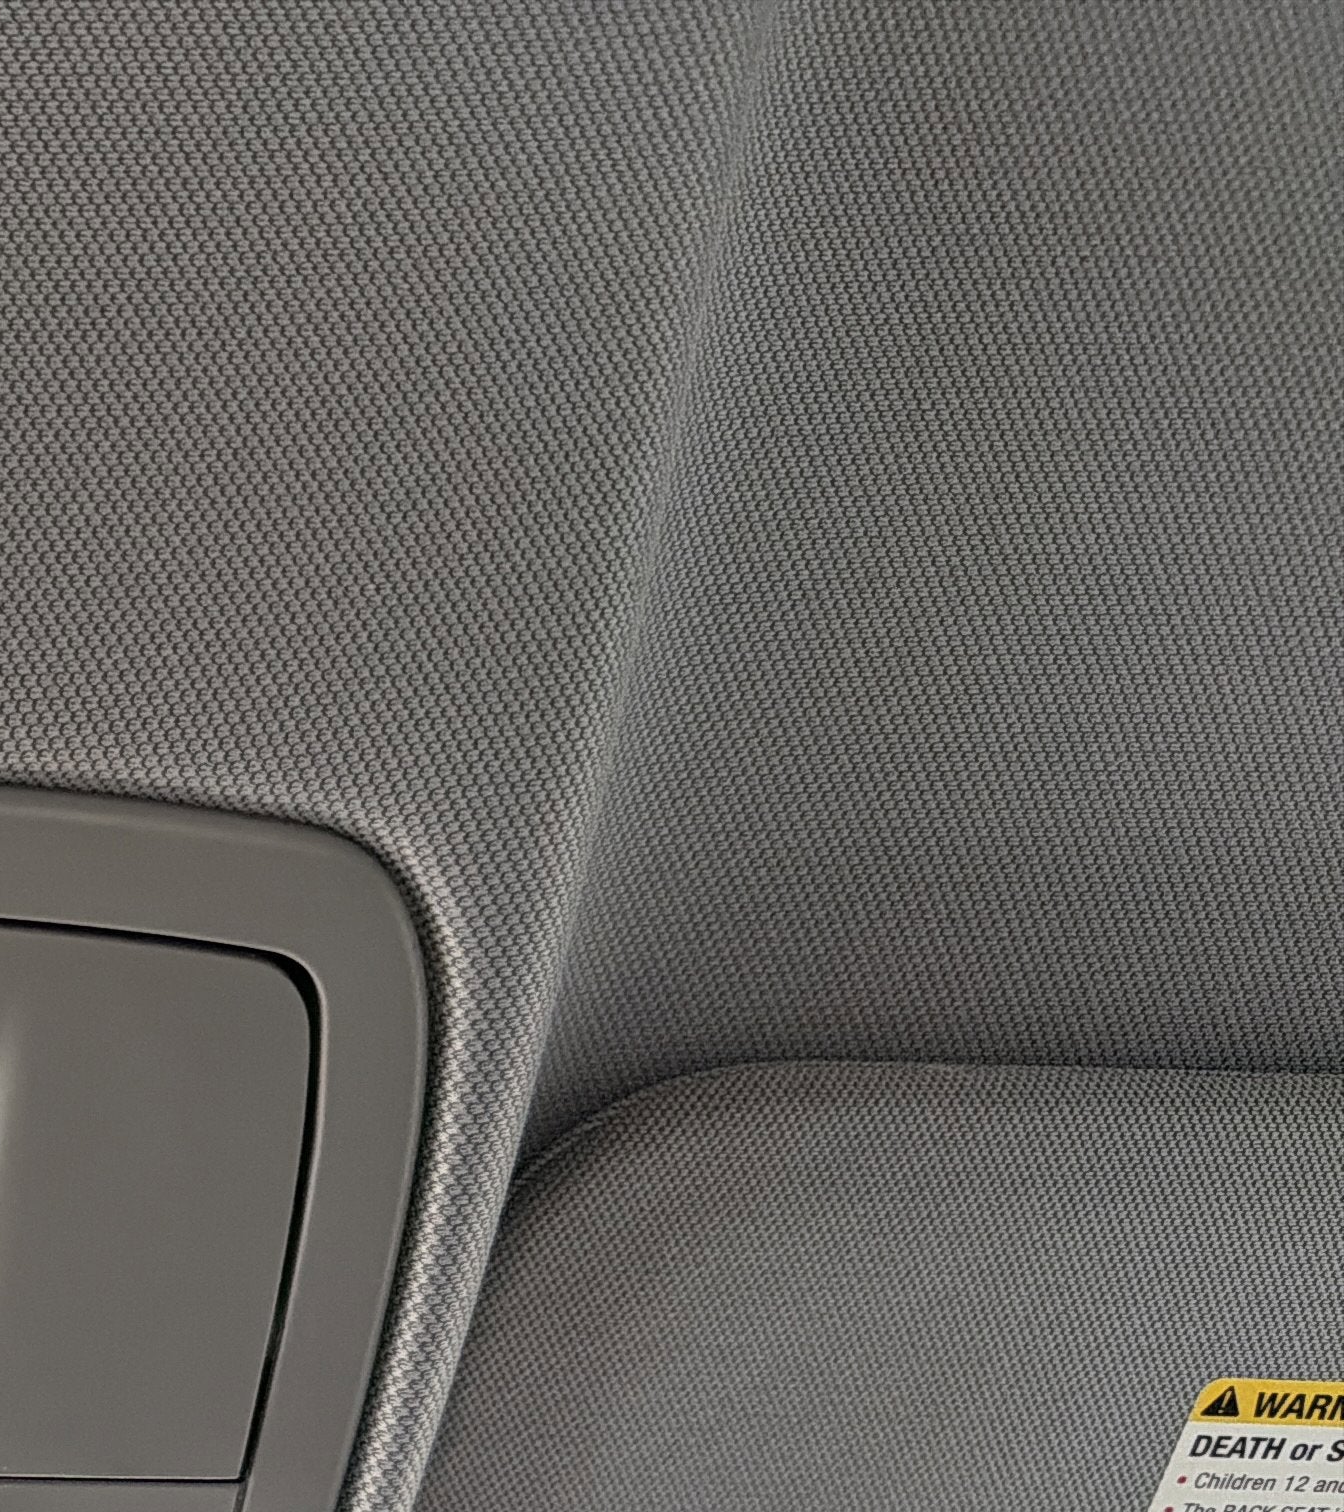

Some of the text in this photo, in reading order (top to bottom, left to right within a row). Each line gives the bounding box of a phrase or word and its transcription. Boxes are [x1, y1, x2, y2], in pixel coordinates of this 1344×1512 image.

[1189, 1434, 1287, 1461] DEATH
[1289, 1443, 1323, 1461] or
[1194, 1472, 1276, 1492] Children
[1284, 1475, 1311, 1492] 12
